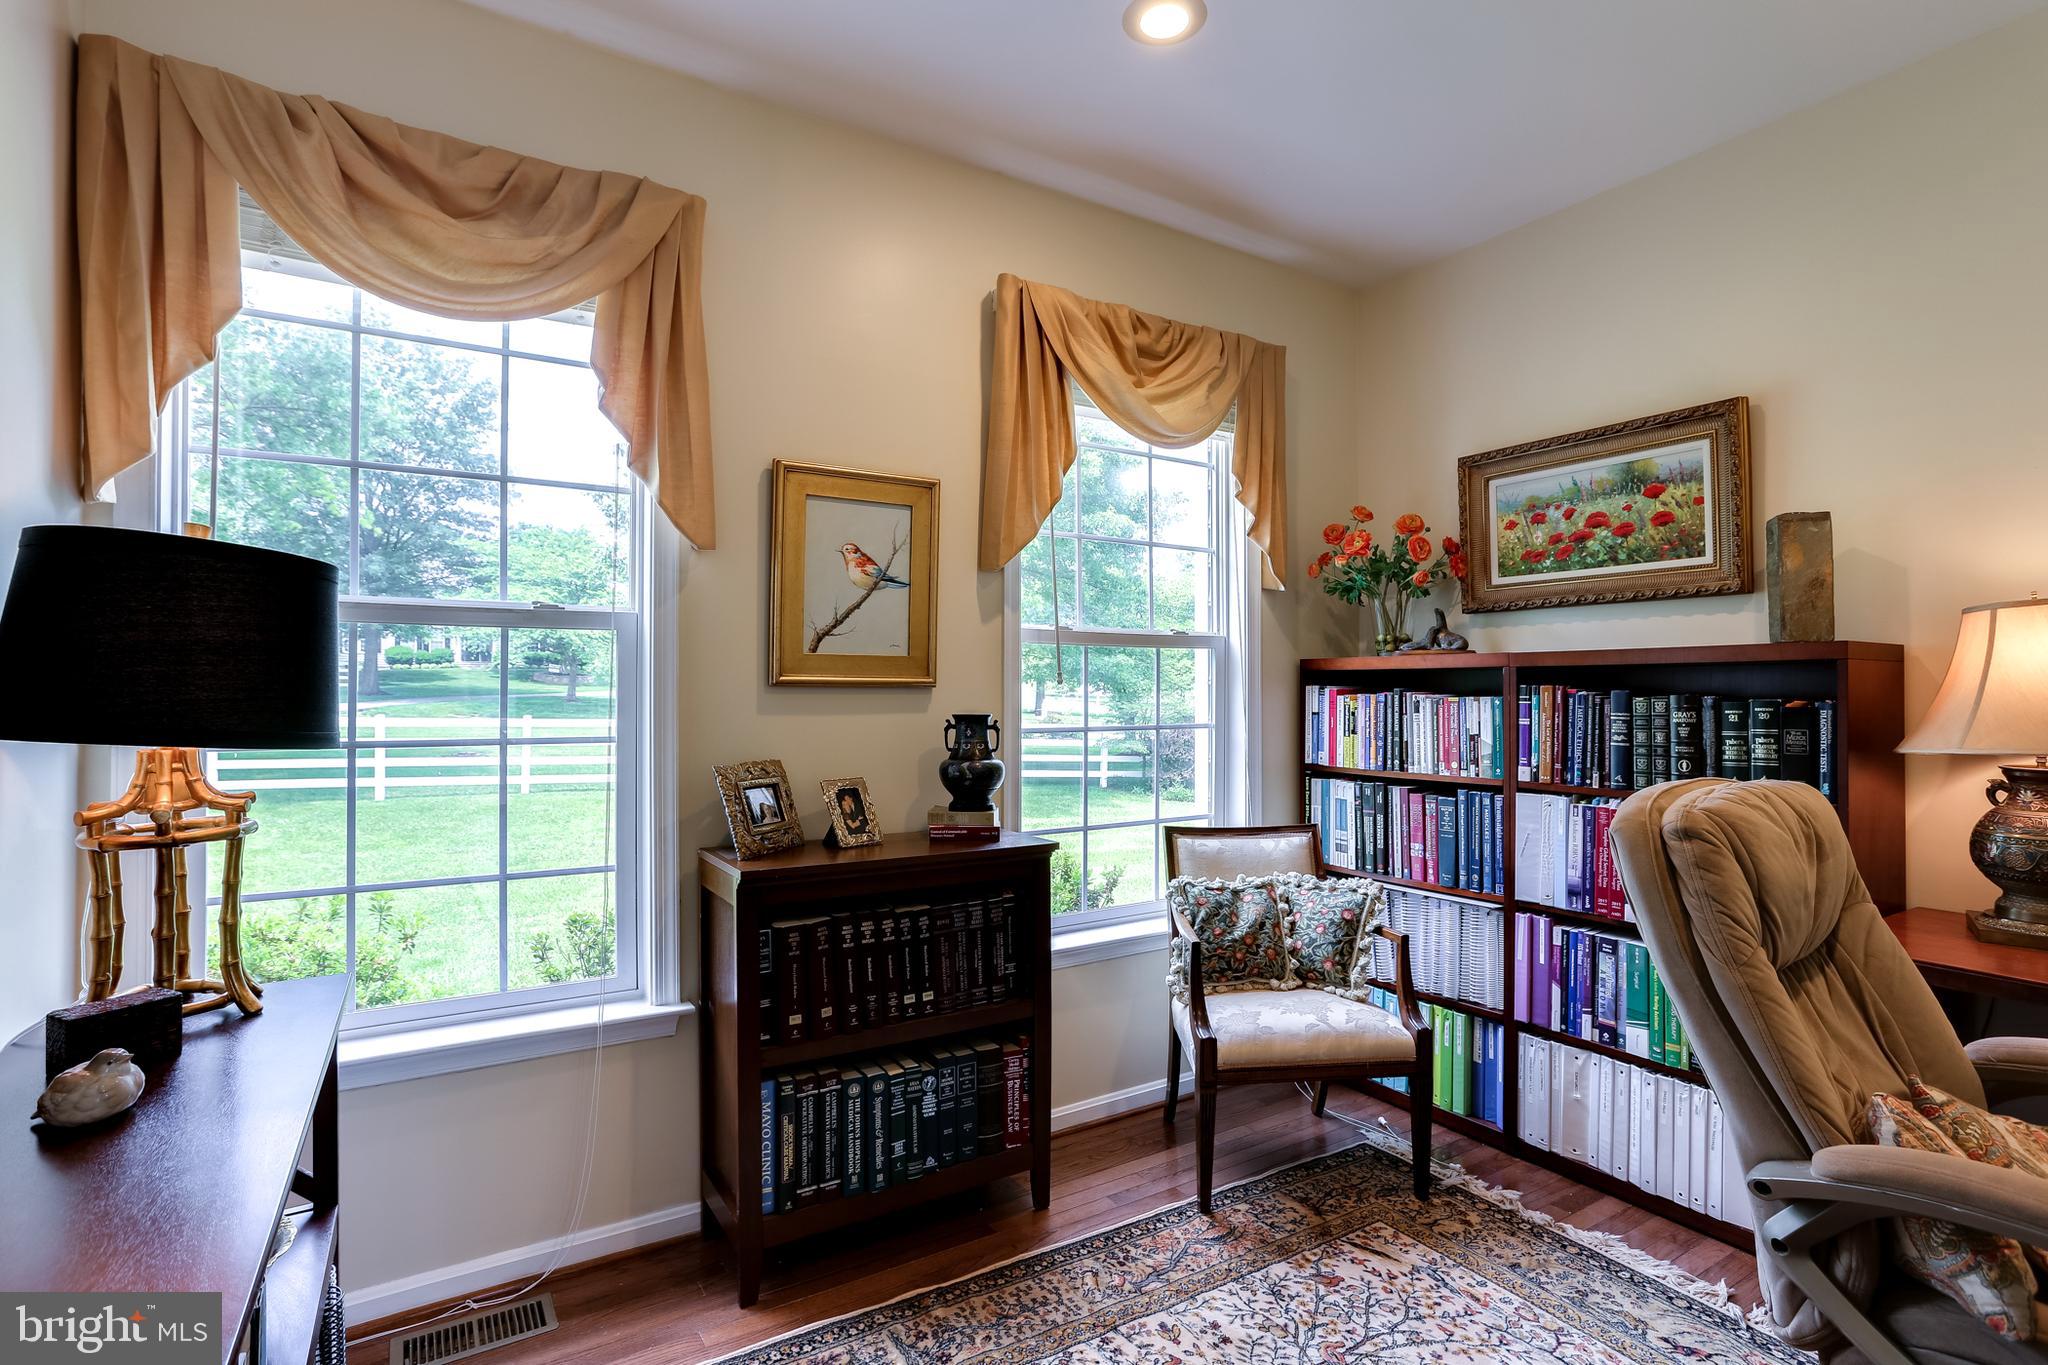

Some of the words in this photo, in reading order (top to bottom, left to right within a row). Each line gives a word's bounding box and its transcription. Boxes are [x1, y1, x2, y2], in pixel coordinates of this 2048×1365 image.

[1672, 711, 1696, 719] GRAY'S
[1728, 714, 1739, 722] 21
[1758, 712, 1770, 720] 20
[1819, 709, 1827, 753] DIAGNOSTIC
[1819, 753, 1827, 773] TESTS
[1495, 797, 1503, 838] Fibromyalgia
[1599, 969, 1607, 1016] ANATOMY
[761, 1102, 771, 1139] MAYO
[873, 1096, 884, 1131] Symptoms
[1013, 1121, 1020, 1132] OF
[876, 1129, 883, 1139] &
[761, 1141, 771, 1187] CLINIC
[876, 1138, 884, 1170] Remedies
